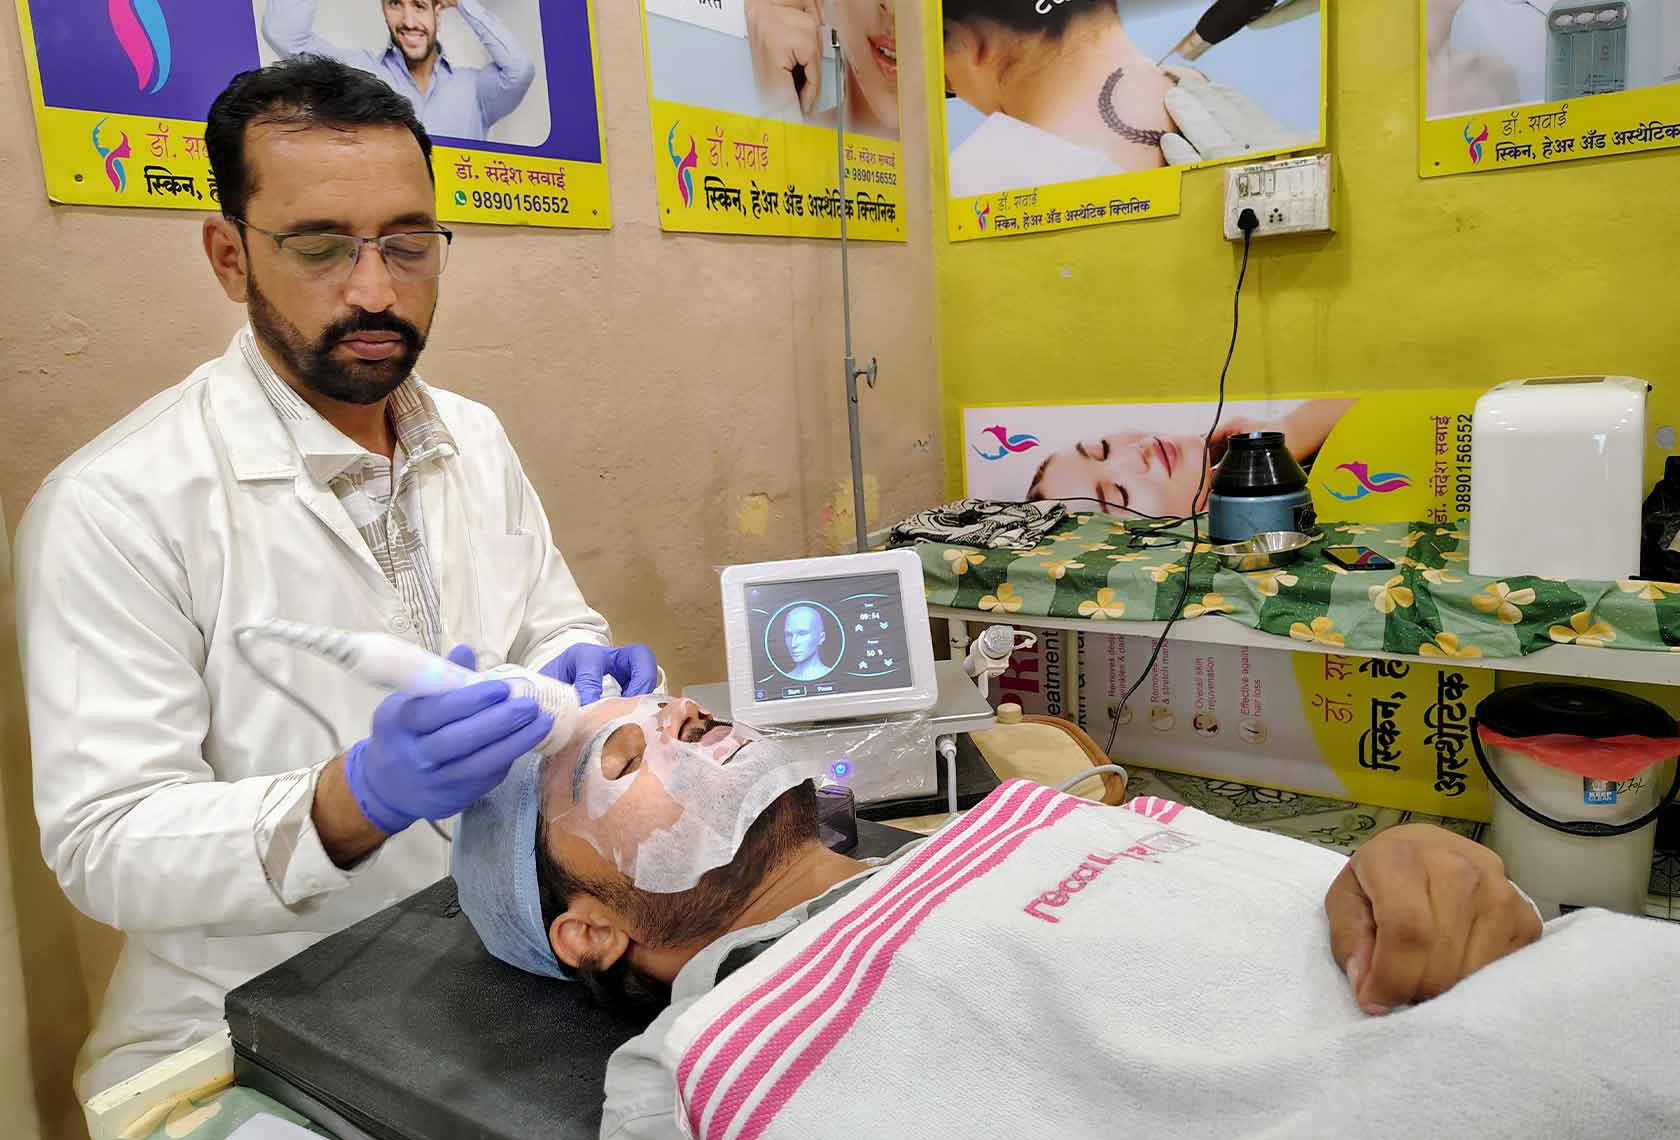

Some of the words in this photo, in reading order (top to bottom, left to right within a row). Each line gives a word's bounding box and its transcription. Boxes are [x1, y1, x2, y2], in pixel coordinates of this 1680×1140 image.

[1502, 112, 1522, 136] डॉ.
[1528, 104, 1568, 131] सवाई
[145, 122, 176, 158] डॉ.
[1496, 141, 1536, 161] स्किन,
[1543, 136, 1575, 159] हेअर
[144, 165, 203, 201] स्किन,
[454, 154, 479, 180] डॉ.
[527, 167, 565, 190] सवाई
[472, 190, 569, 214] 9890156552
[704, 175, 747, 217] स्किन,
[751, 181, 779, 219] हेअर
[857, 191, 896, 223] क्लिनिक
[1456, 414, 1472, 513] 9890156552
[1043, 631, 1061, 716] eatment
[1193, 657, 1203, 675] skin
[1205, 656, 1216, 711] rejuvenation
[1193, 678, 1203, 709] Overall
[1240, 677, 1250, 715] Effective
[1251, 679, 1262, 698] loss
[1251, 700, 1262, 718] hair
[1359, 691, 1408, 772] स्किन,
[1423, 670, 1470, 797] अस्थेटिक
